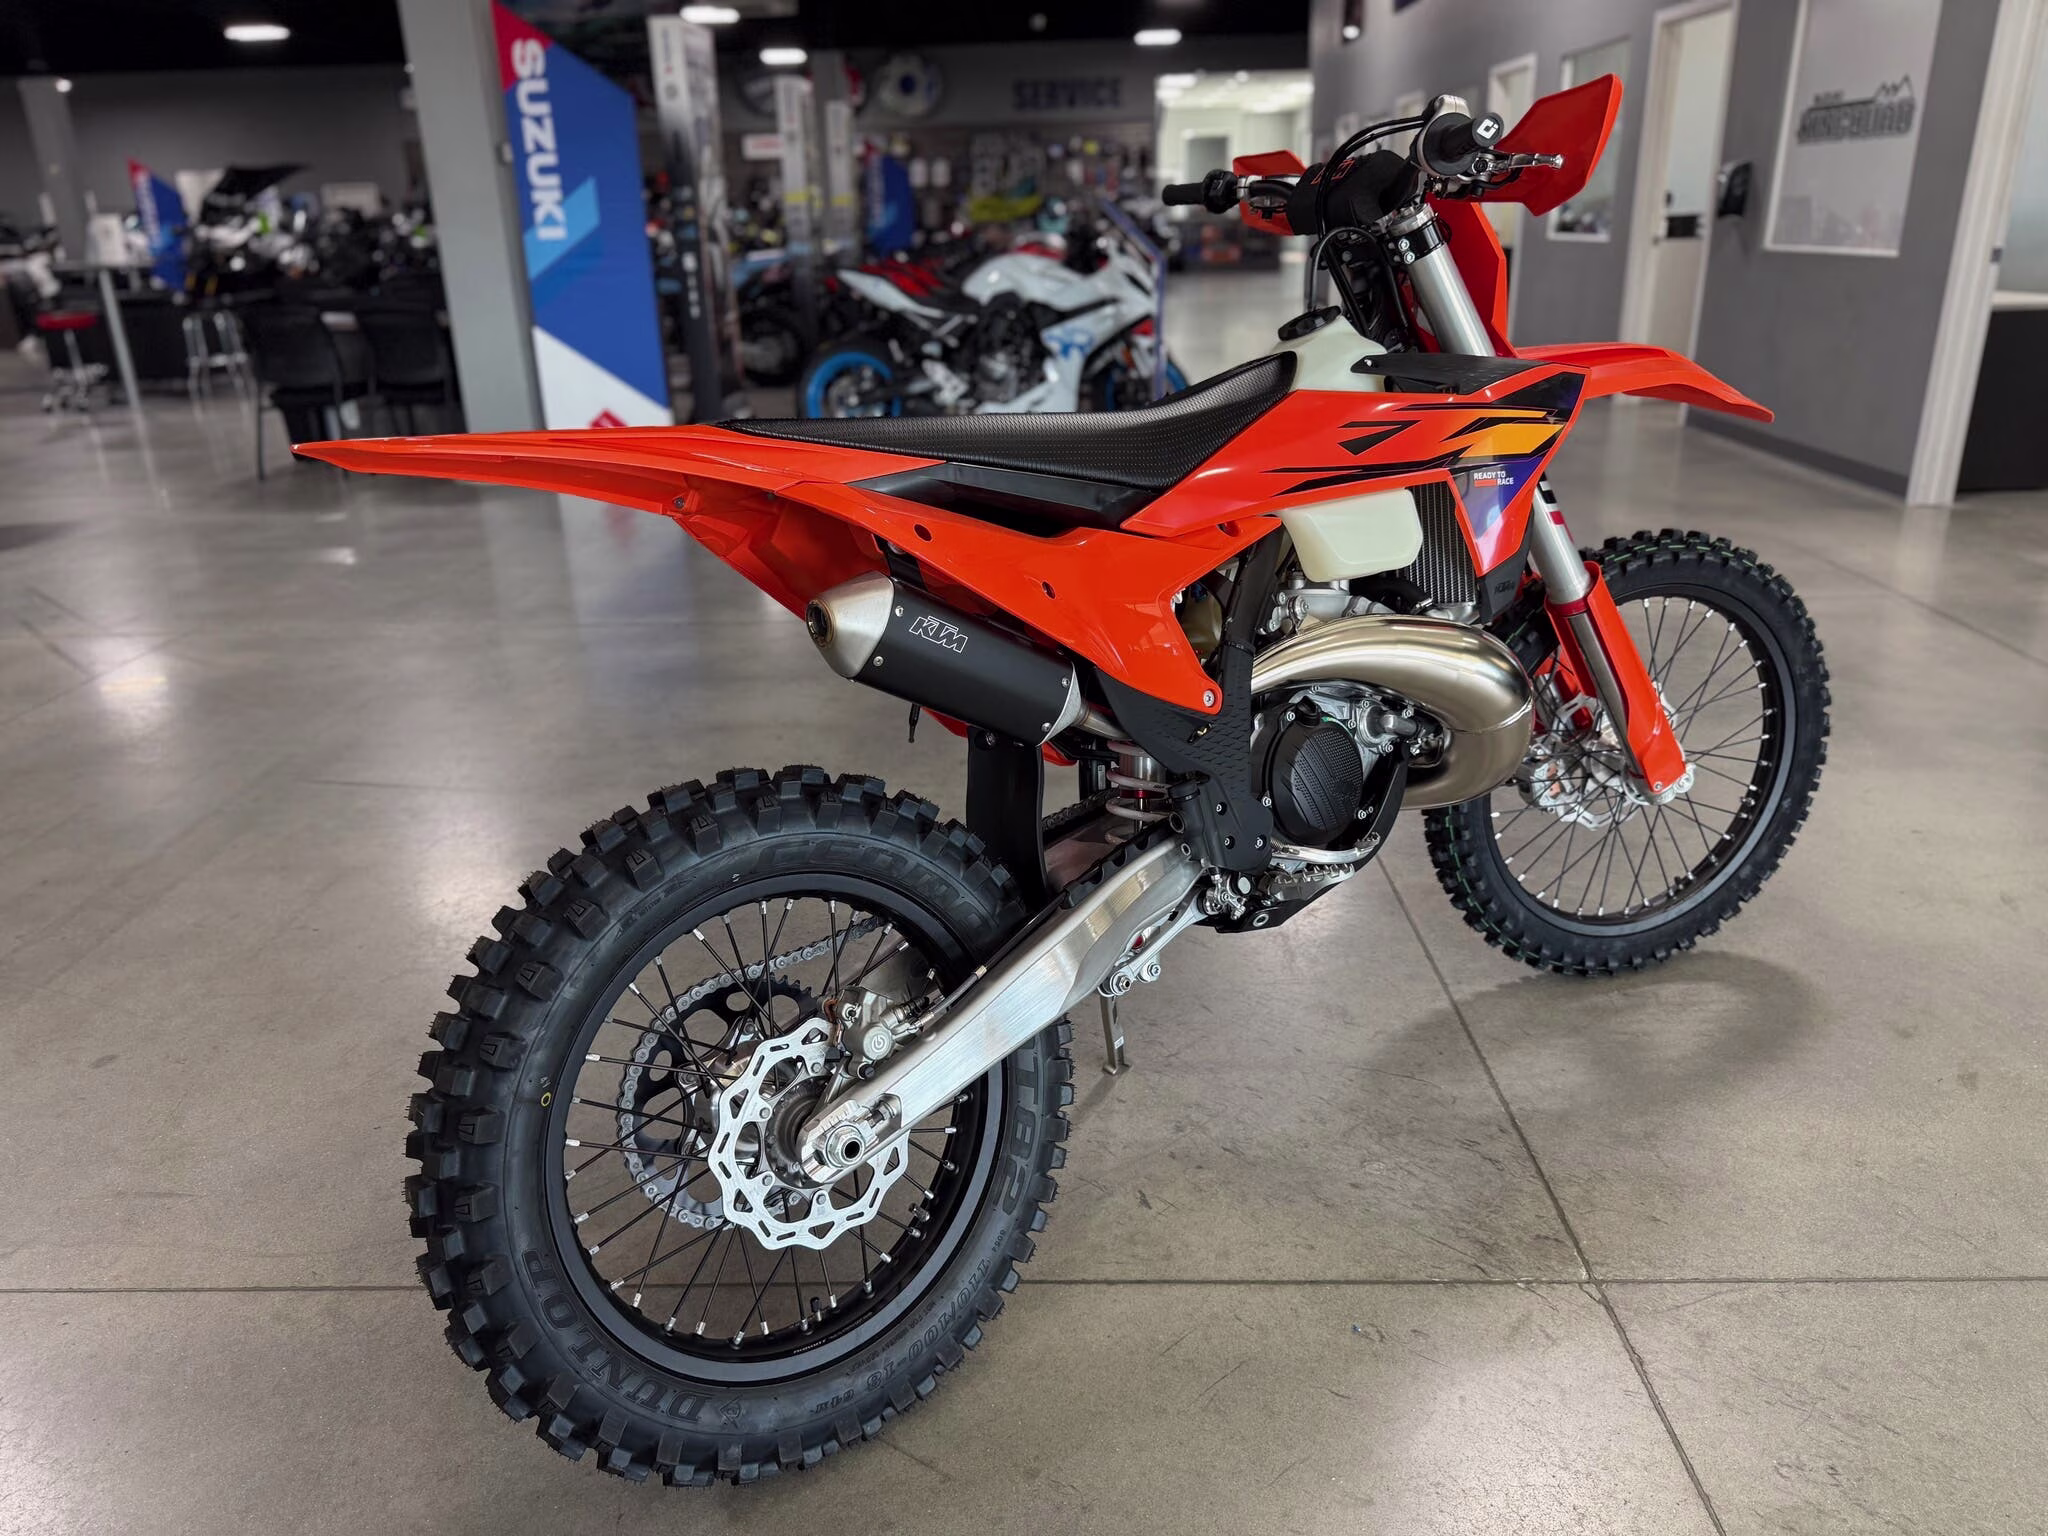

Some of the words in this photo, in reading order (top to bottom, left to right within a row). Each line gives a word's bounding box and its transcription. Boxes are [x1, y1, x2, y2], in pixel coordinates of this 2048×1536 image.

[511, 38, 566, 242] SUZUKI
[1473, 472, 1496, 480] READY
[1497, 470, 1506, 478] TO
[1497, 477, 1514, 485] RACE
[909, 615, 968, 654] KTM
[522, 1249, 714, 1424] DUNLOP
